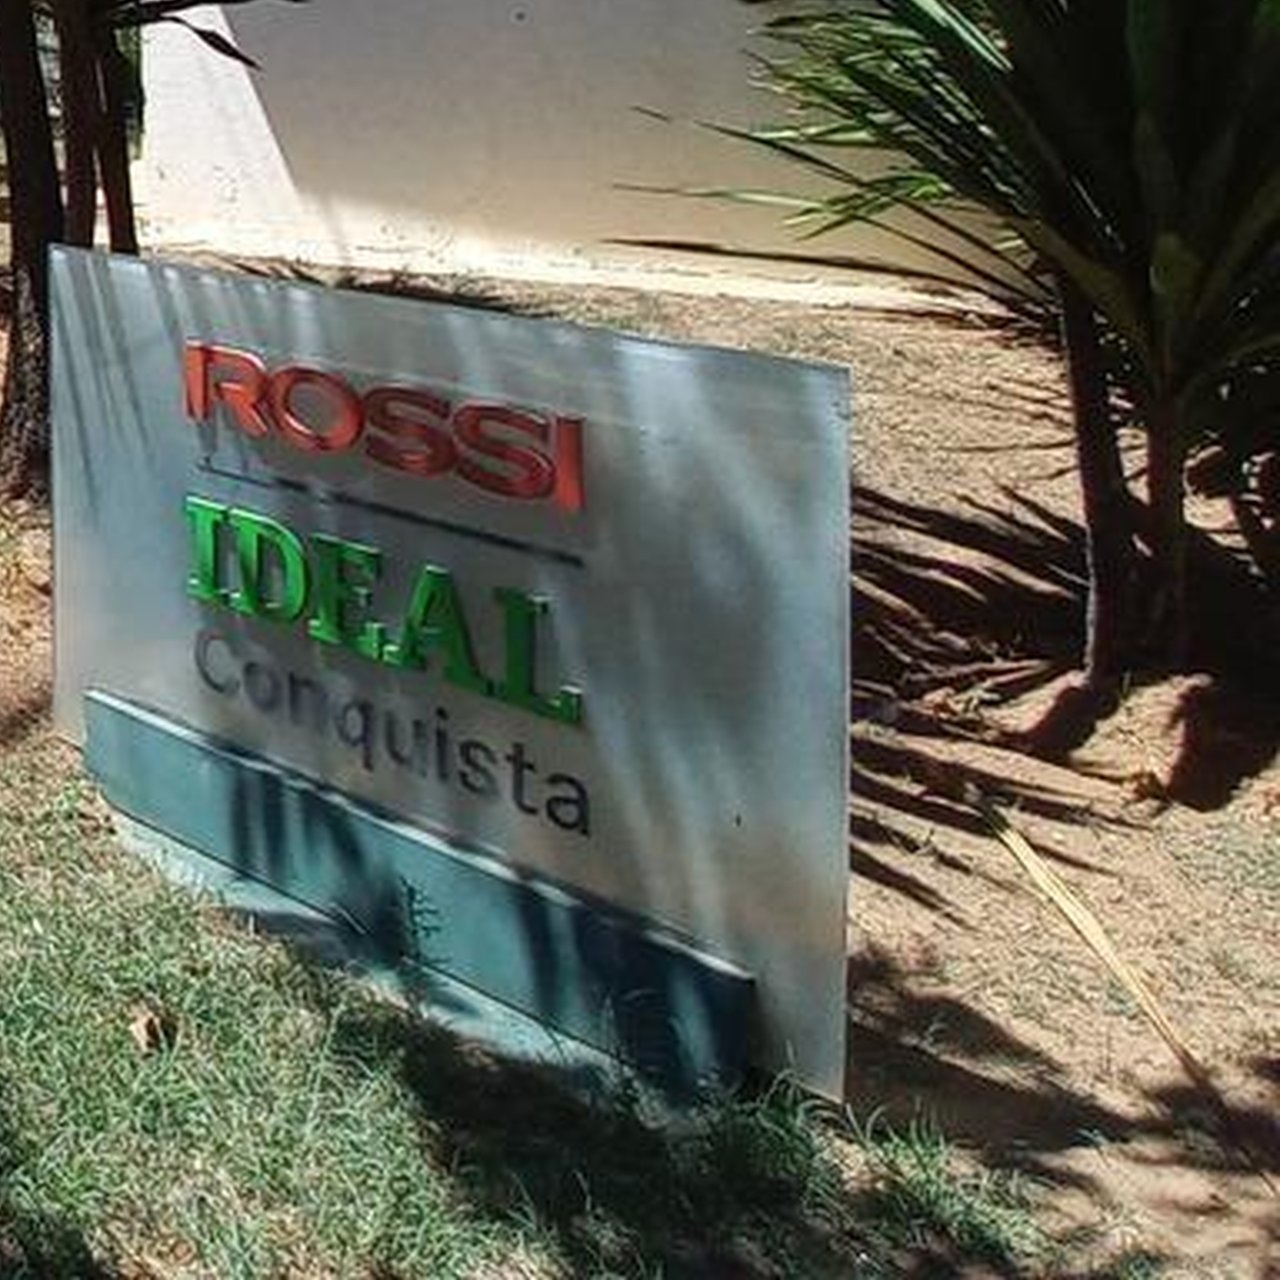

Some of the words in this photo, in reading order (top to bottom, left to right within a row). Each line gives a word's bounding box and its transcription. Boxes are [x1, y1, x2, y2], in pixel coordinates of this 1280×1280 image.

[185, 339, 587, 511] ROSSI
[185, 496, 583, 725] IDEAL
[195, 627, 590, 837] Conquista
